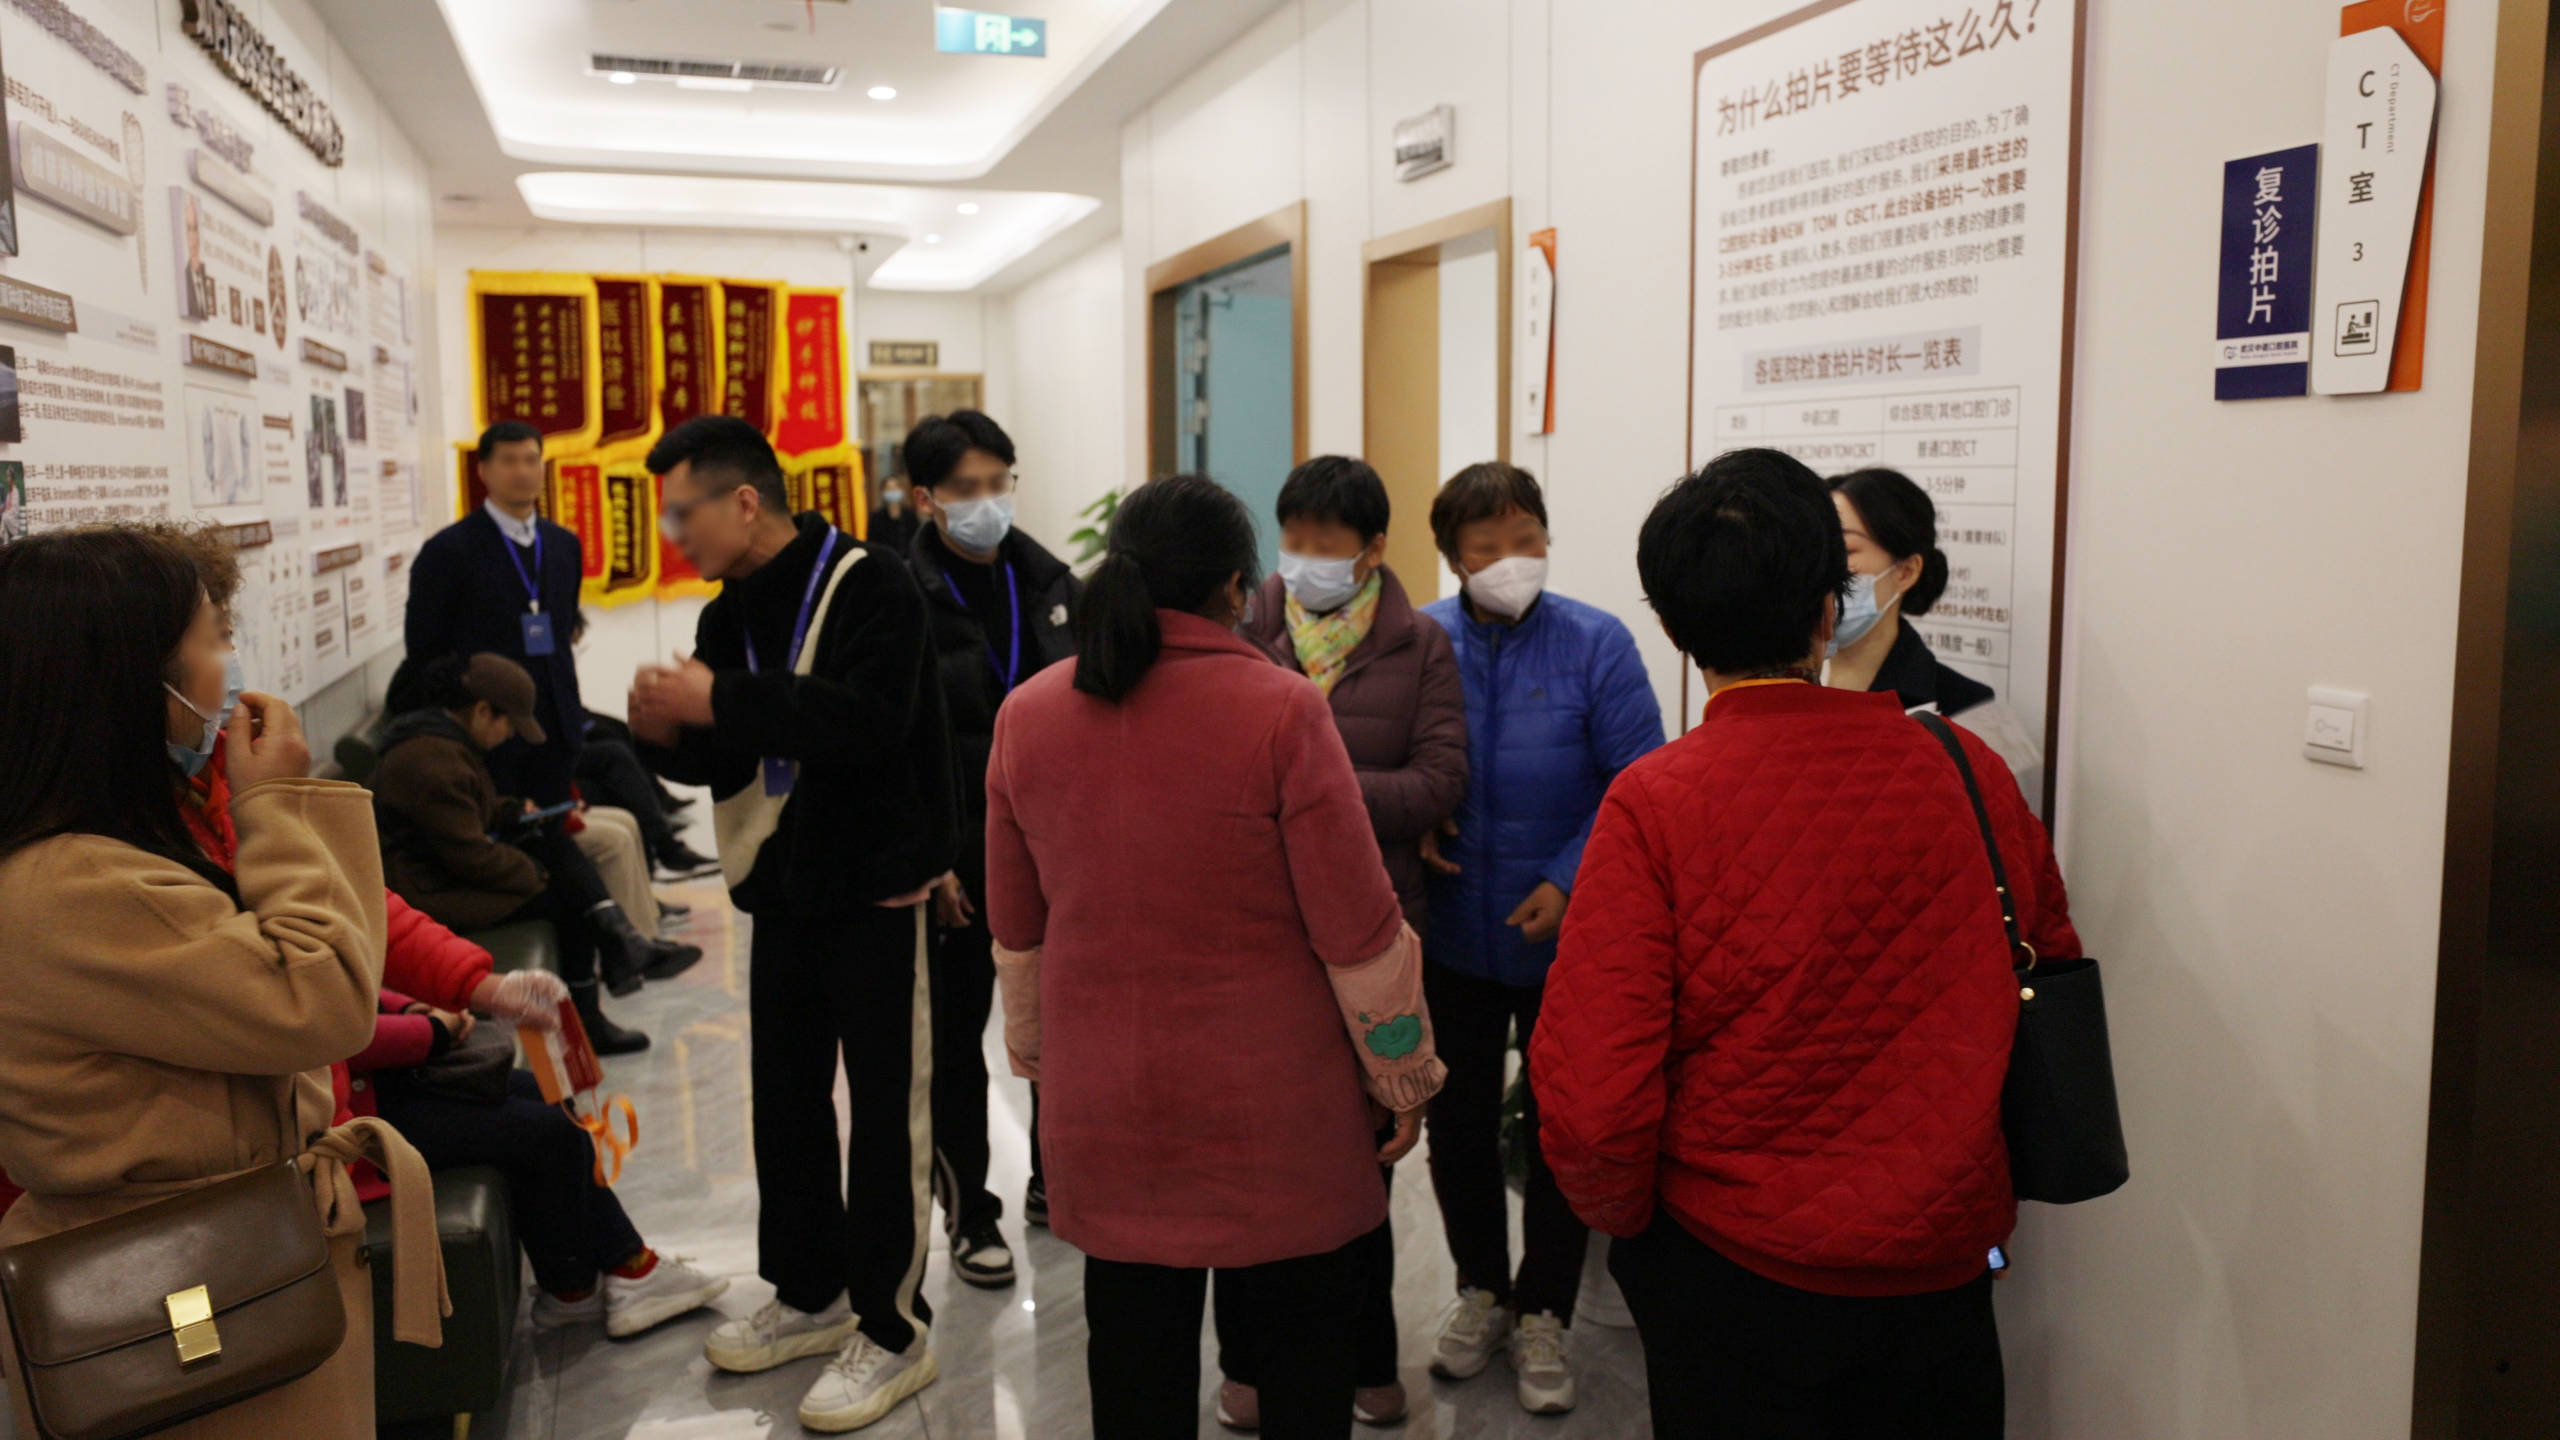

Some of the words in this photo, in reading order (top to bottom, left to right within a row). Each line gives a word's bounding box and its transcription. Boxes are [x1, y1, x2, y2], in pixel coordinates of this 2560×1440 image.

[1716, 0, 2041, 136] 为什么拍片要等待这么久？
[2385, 83, 2400, 155] Department
[2246, 165, 2284, 325] 复诊拍片
[2351, 242, 2364, 262] 3
[1754, 337, 1963, 384] 各医院检查拍片时长一览表
